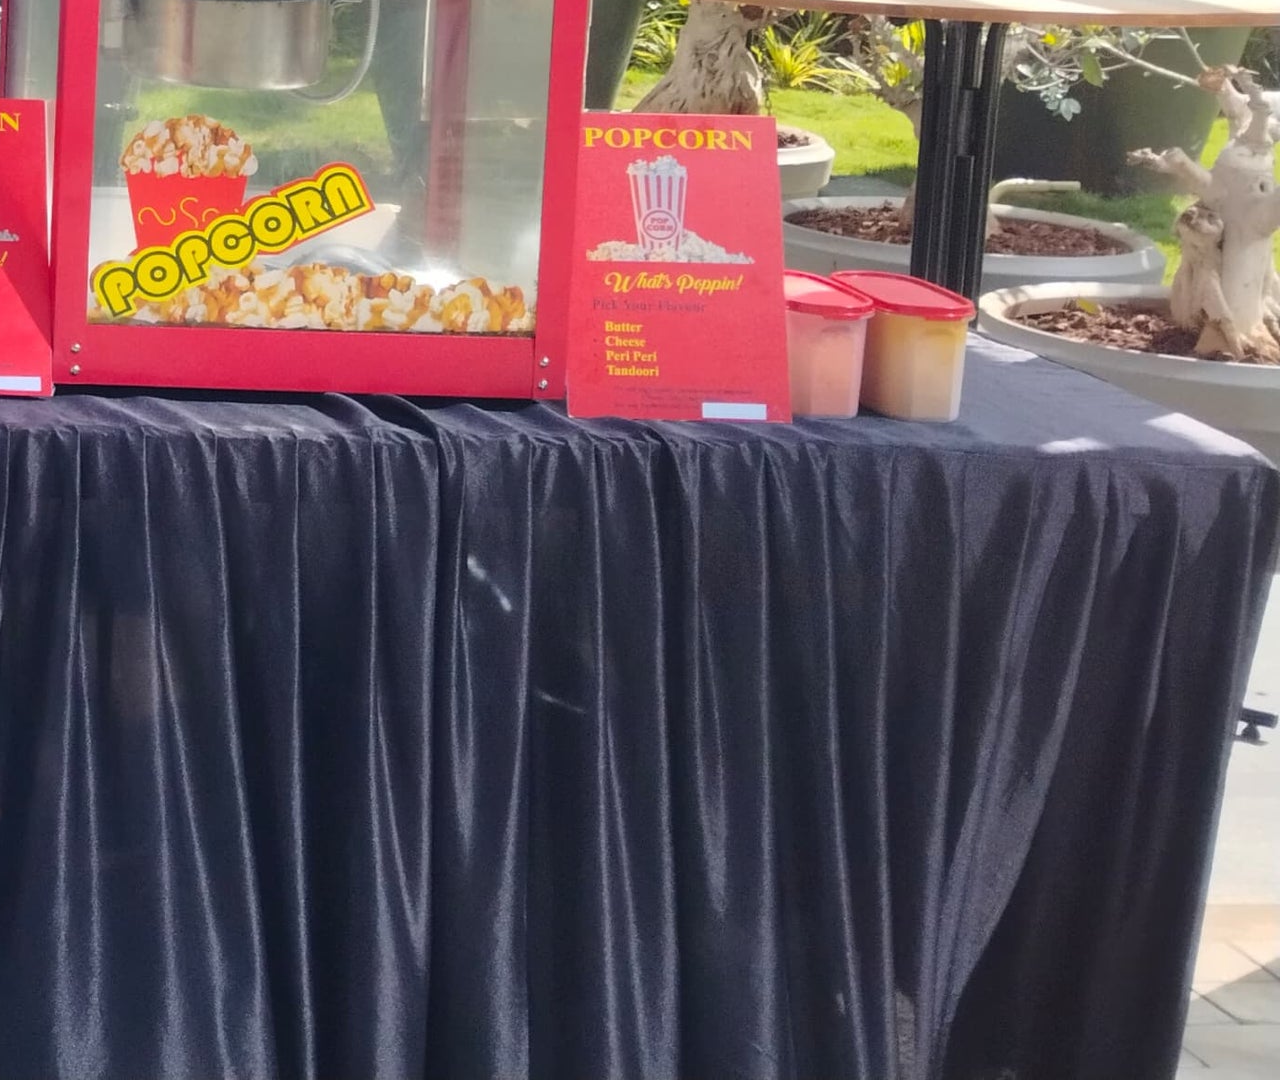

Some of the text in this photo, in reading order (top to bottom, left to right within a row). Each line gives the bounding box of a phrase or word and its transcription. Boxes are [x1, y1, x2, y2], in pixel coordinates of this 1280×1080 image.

[583, 126, 753, 151] POPCORN
[646, 224, 674, 232] CORN
[99, 171, 366, 317] POPCORN
[604, 272, 744, 296] What's Poppin!
[604, 321, 643, 333] Butter
[604, 335, 646, 347] Cheese
[605, 350, 657, 362] Peri Peri
[606, 364, 660, 377] Tandoori
